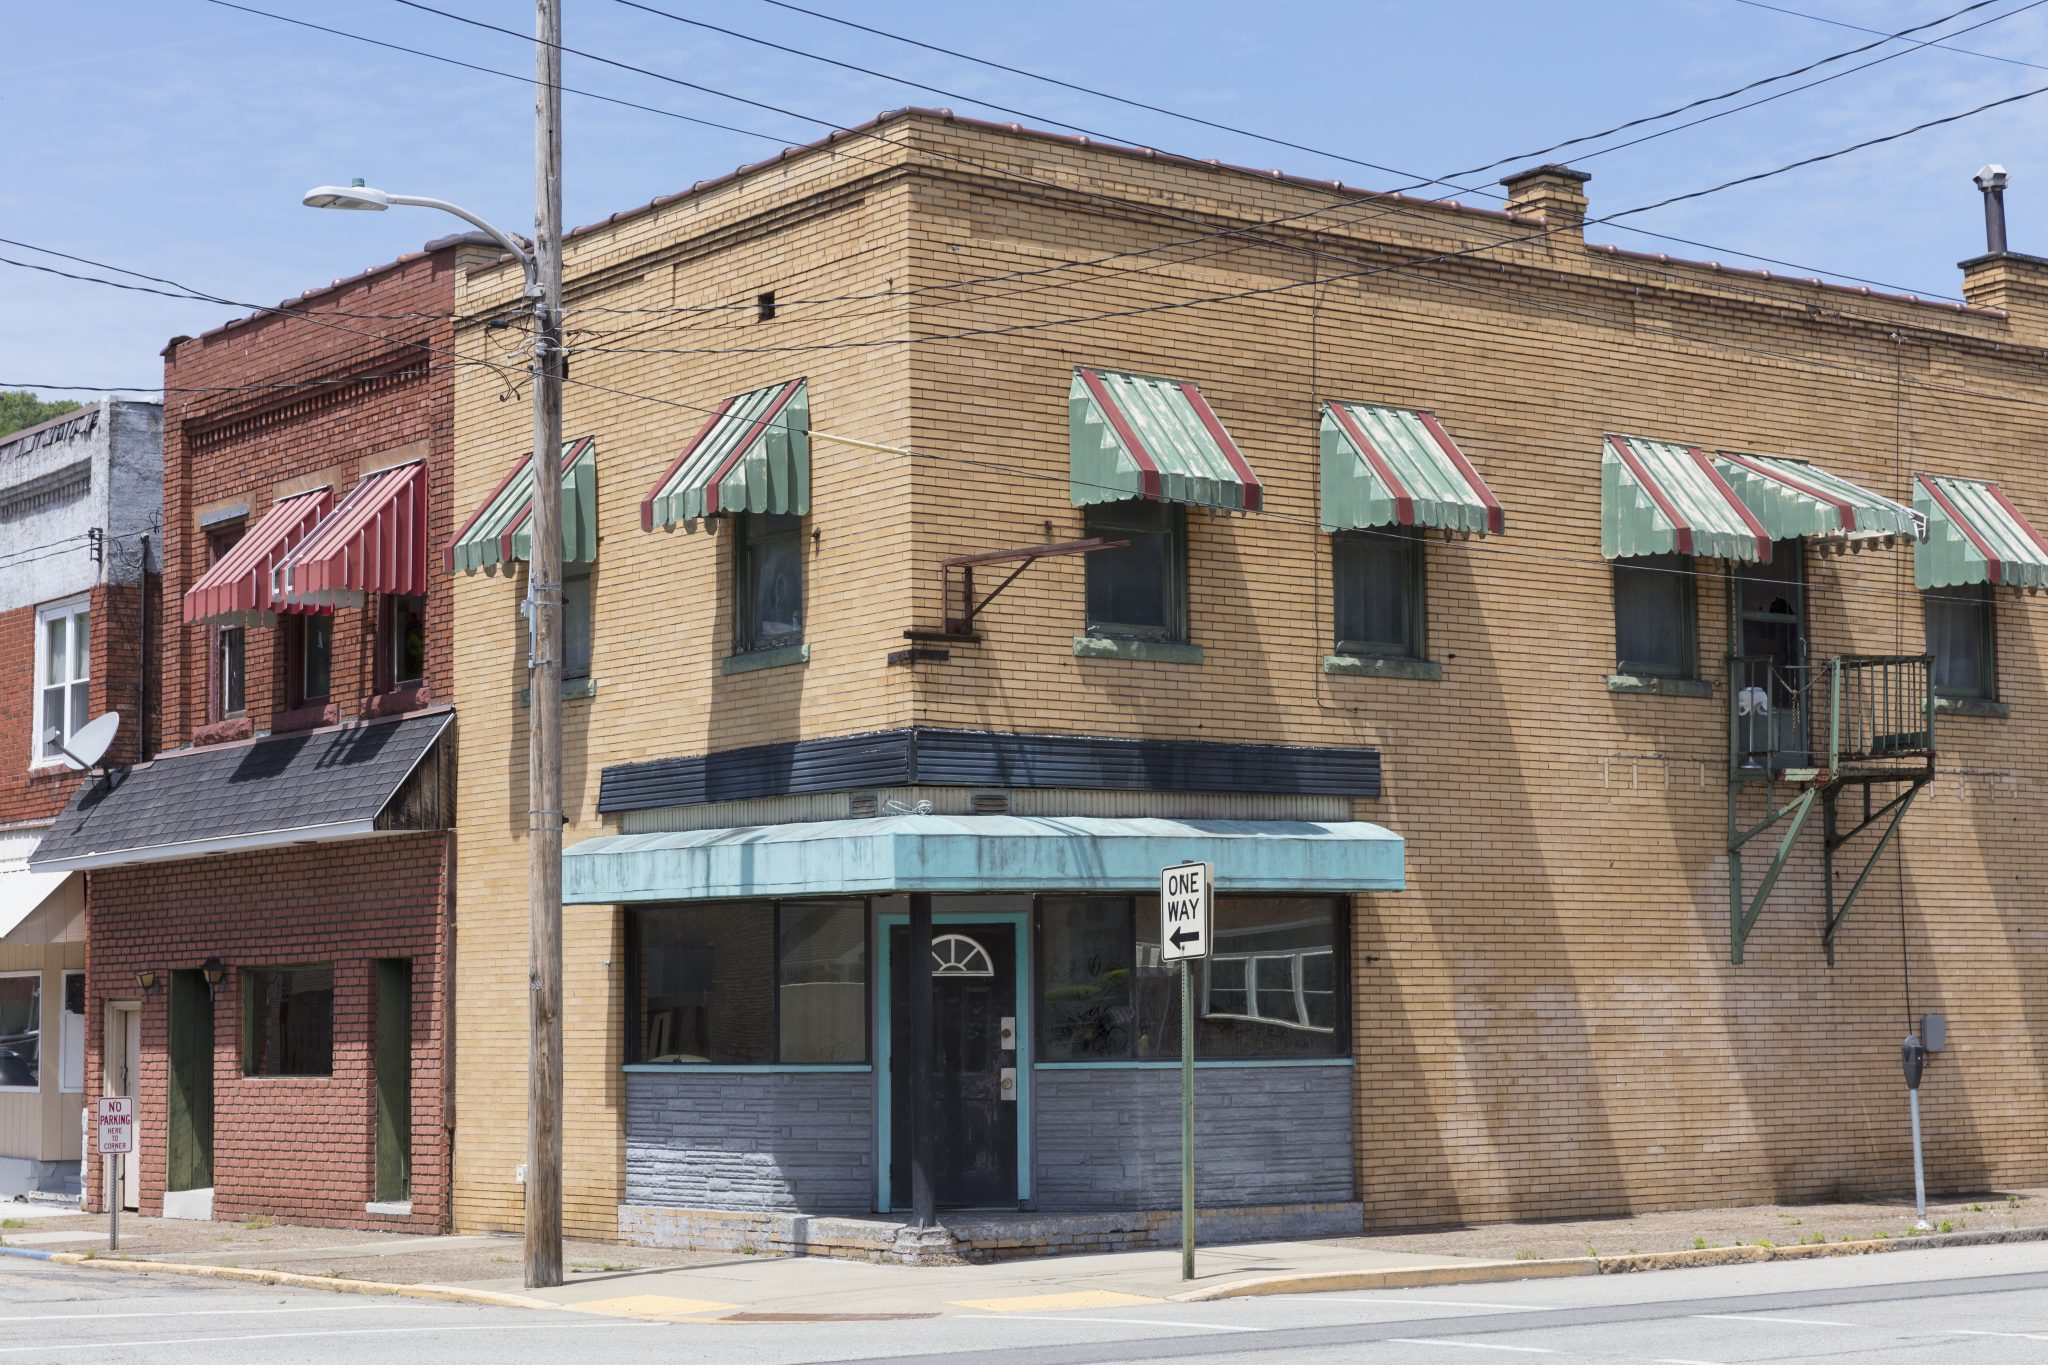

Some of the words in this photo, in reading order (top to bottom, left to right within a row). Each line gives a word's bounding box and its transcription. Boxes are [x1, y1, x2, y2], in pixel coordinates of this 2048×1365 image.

[1168, 872, 1199, 896] ONE
[1168, 898, 1200, 922] WAY
[108, 1101, 122, 1113] NO
[100, 1114, 131, 1125] PARKING
[107, 1127, 123, 1135] HERE
[103, 1142, 127, 1150] CORNER
